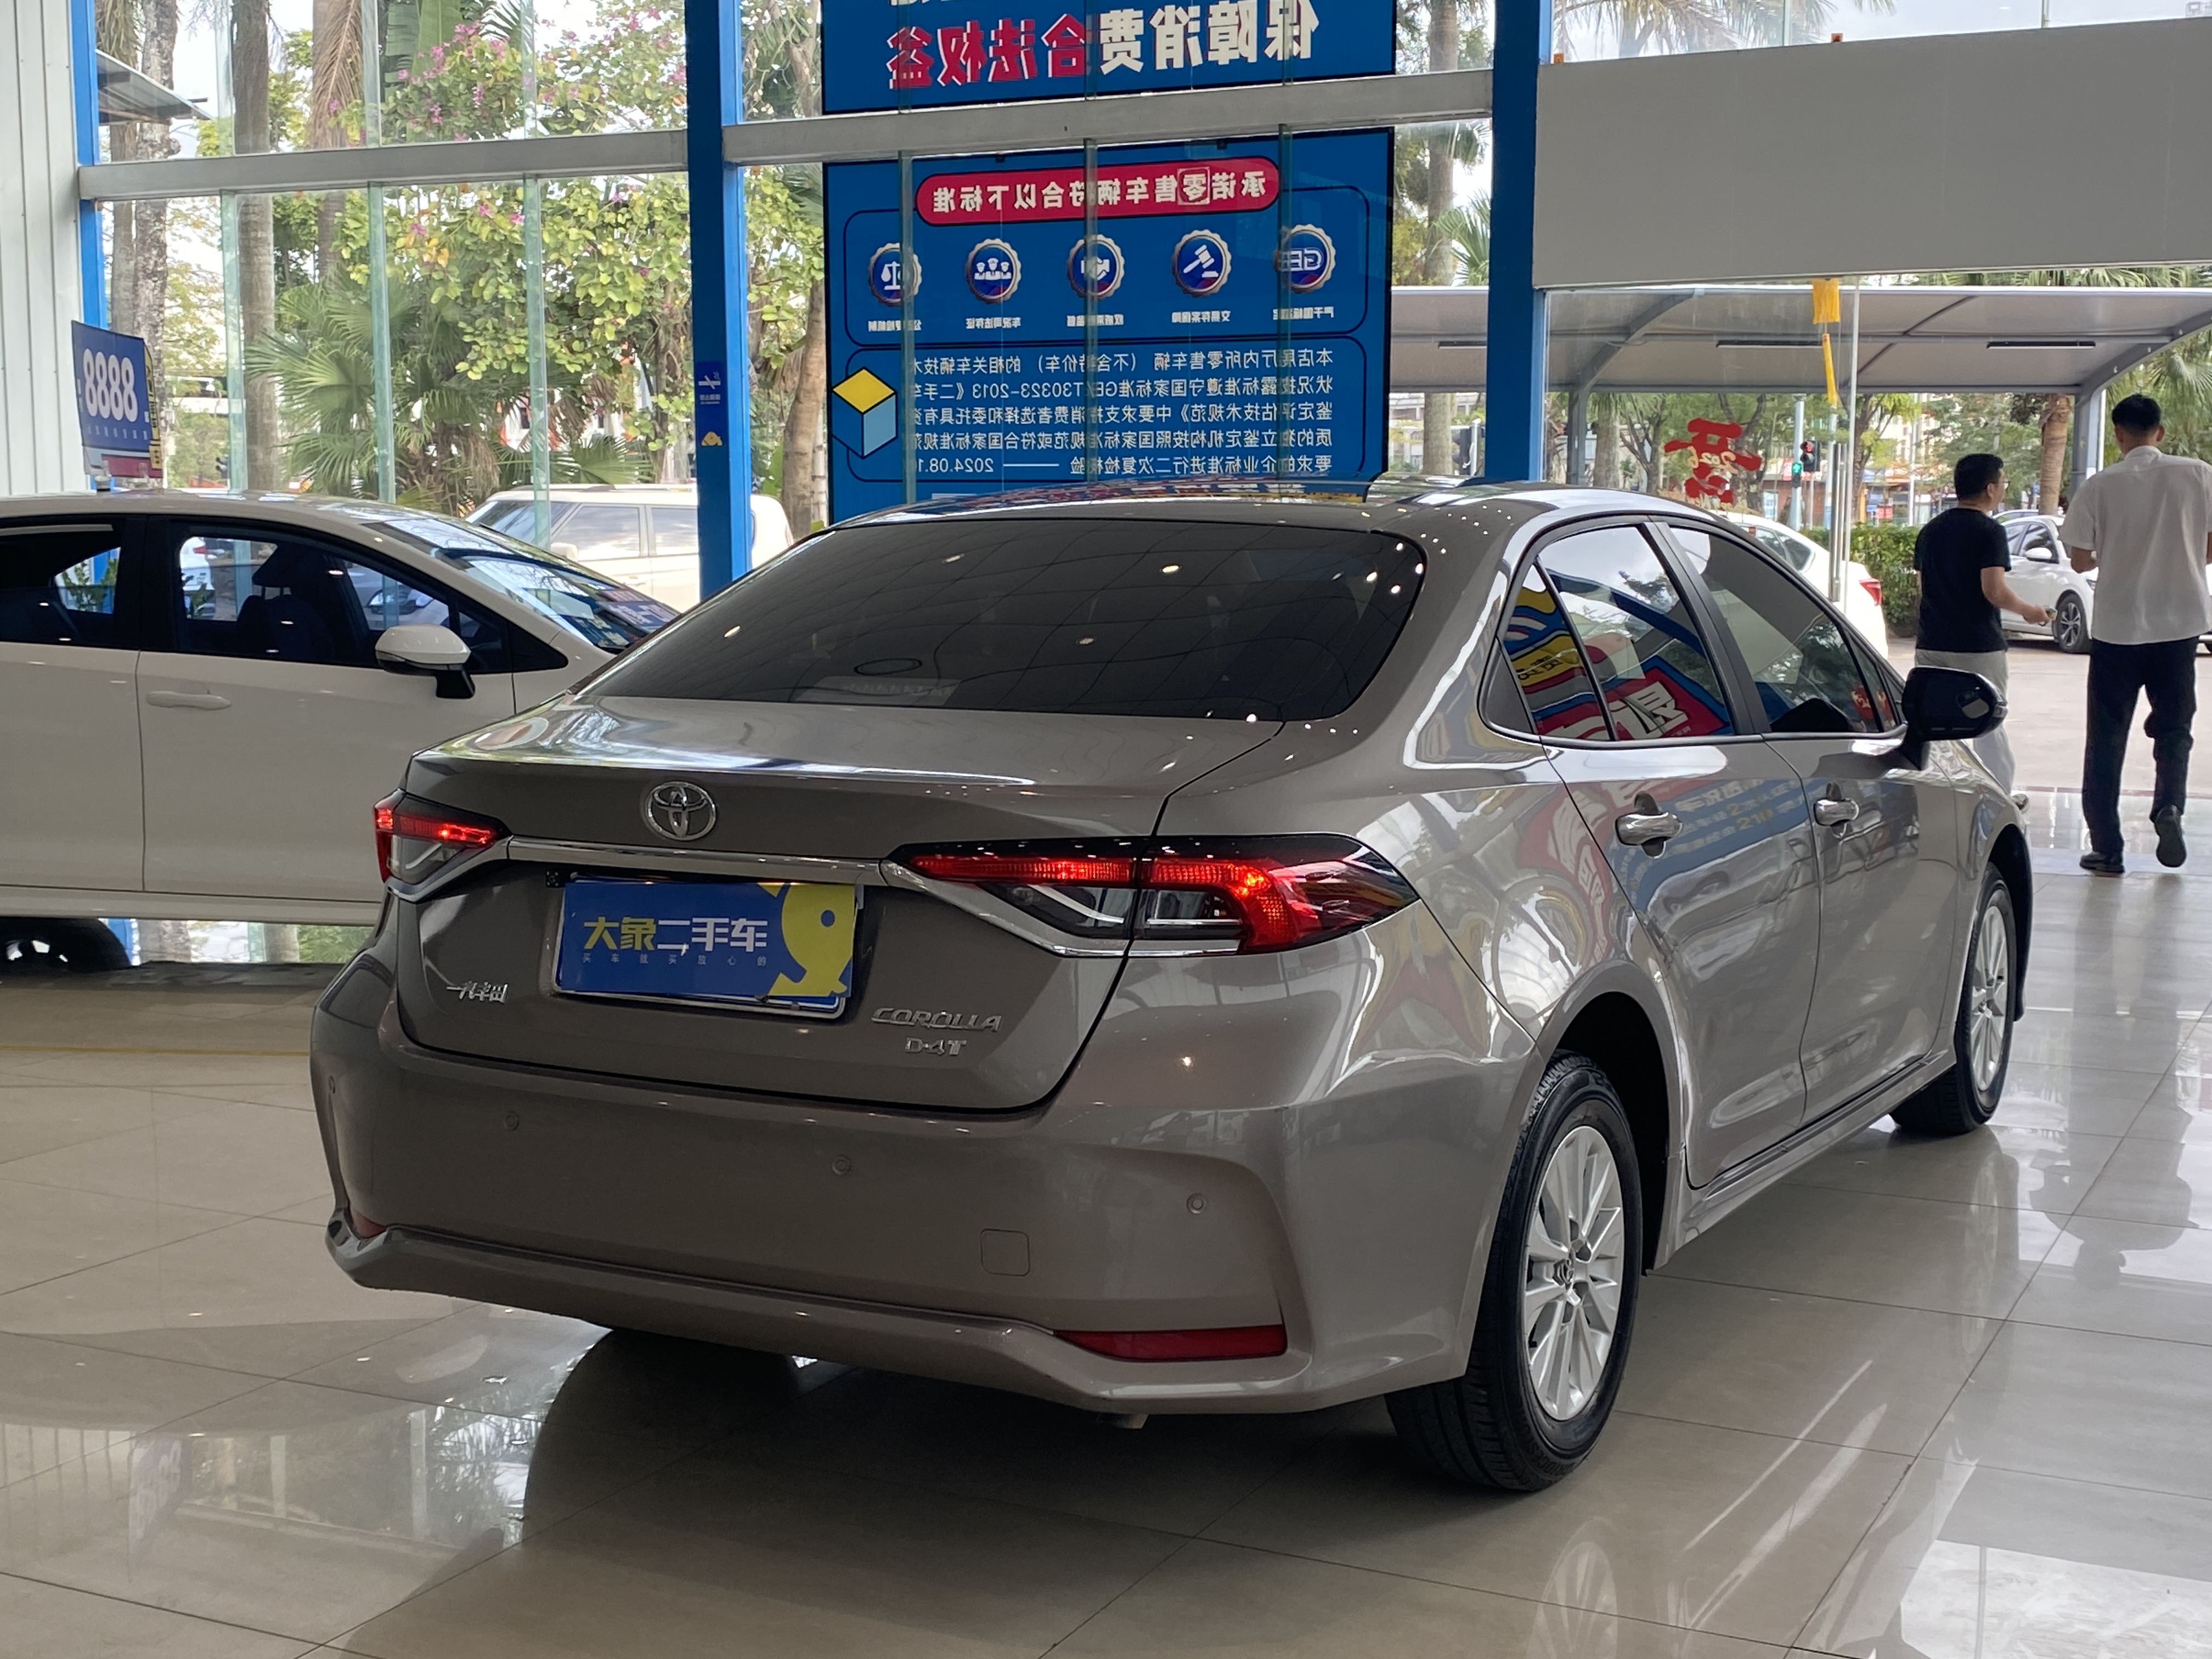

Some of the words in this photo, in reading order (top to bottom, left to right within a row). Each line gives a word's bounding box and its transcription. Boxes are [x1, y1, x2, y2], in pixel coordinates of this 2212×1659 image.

[83, 348, 138, 422] 8888
[584, 916, 768, 952] 大象二手车
[871, 1007, 1002, 1032] COROLLA
